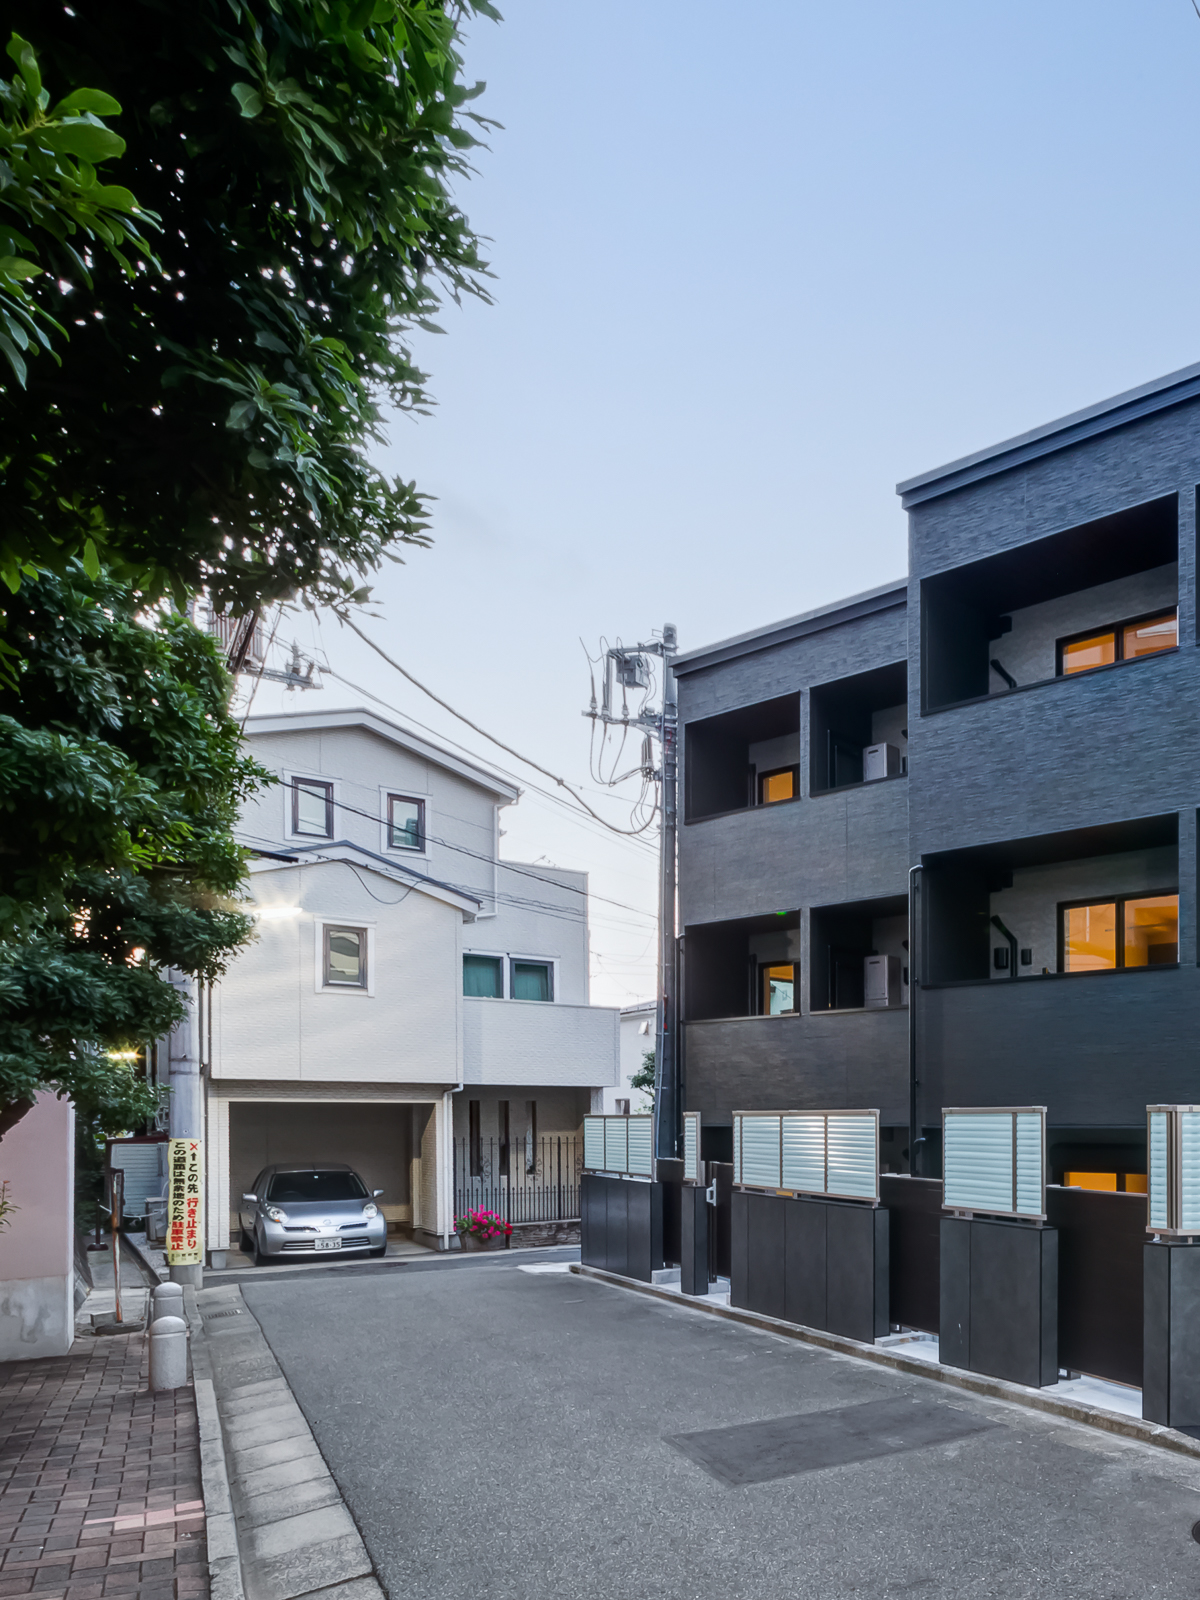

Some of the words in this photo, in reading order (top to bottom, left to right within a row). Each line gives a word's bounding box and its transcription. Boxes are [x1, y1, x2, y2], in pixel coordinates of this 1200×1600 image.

[186, 1197, 198, 1249] 行き止まり
